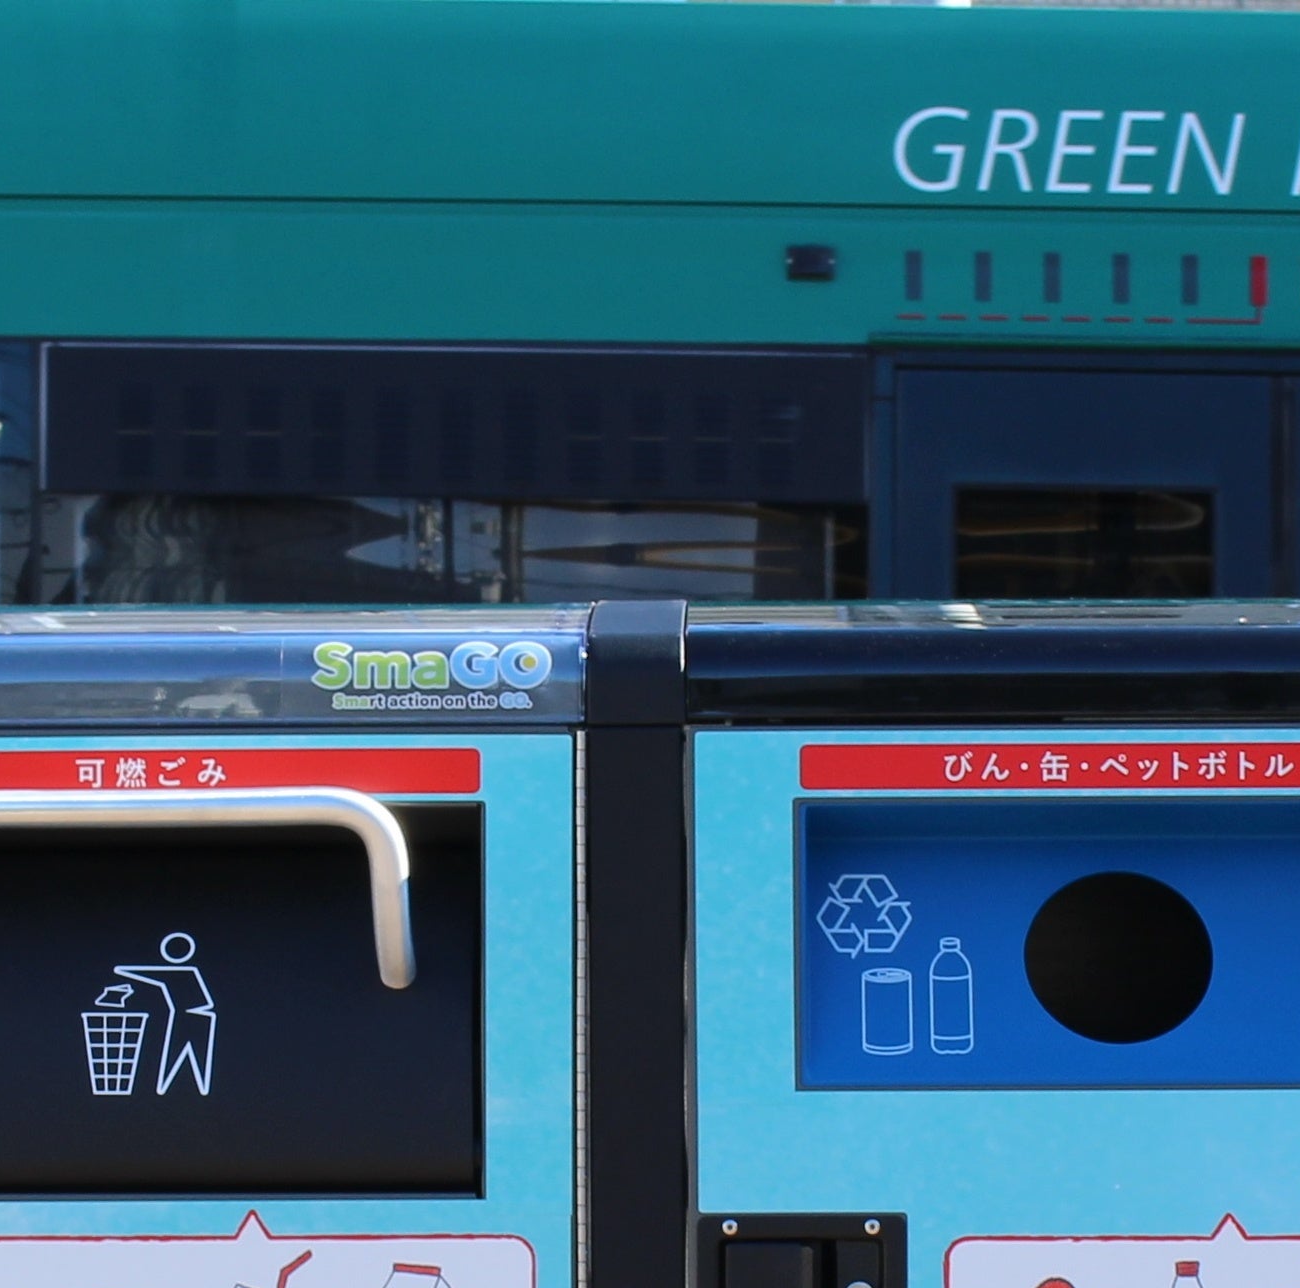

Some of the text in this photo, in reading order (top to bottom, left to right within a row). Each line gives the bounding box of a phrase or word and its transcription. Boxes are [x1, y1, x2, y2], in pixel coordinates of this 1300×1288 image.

[892, 105, 1247, 196] GREEN
[311, 641, 553, 690] SmaGO
[333, 692, 386, 709] Smart
[387, 692, 441, 709] action
[443, 694, 467, 709] on
[467, 692, 497, 709] the
[75, 757, 227, 788] 可燃ごみ
[943, 750, 1295, 782] びん・缶・ペットボトル
